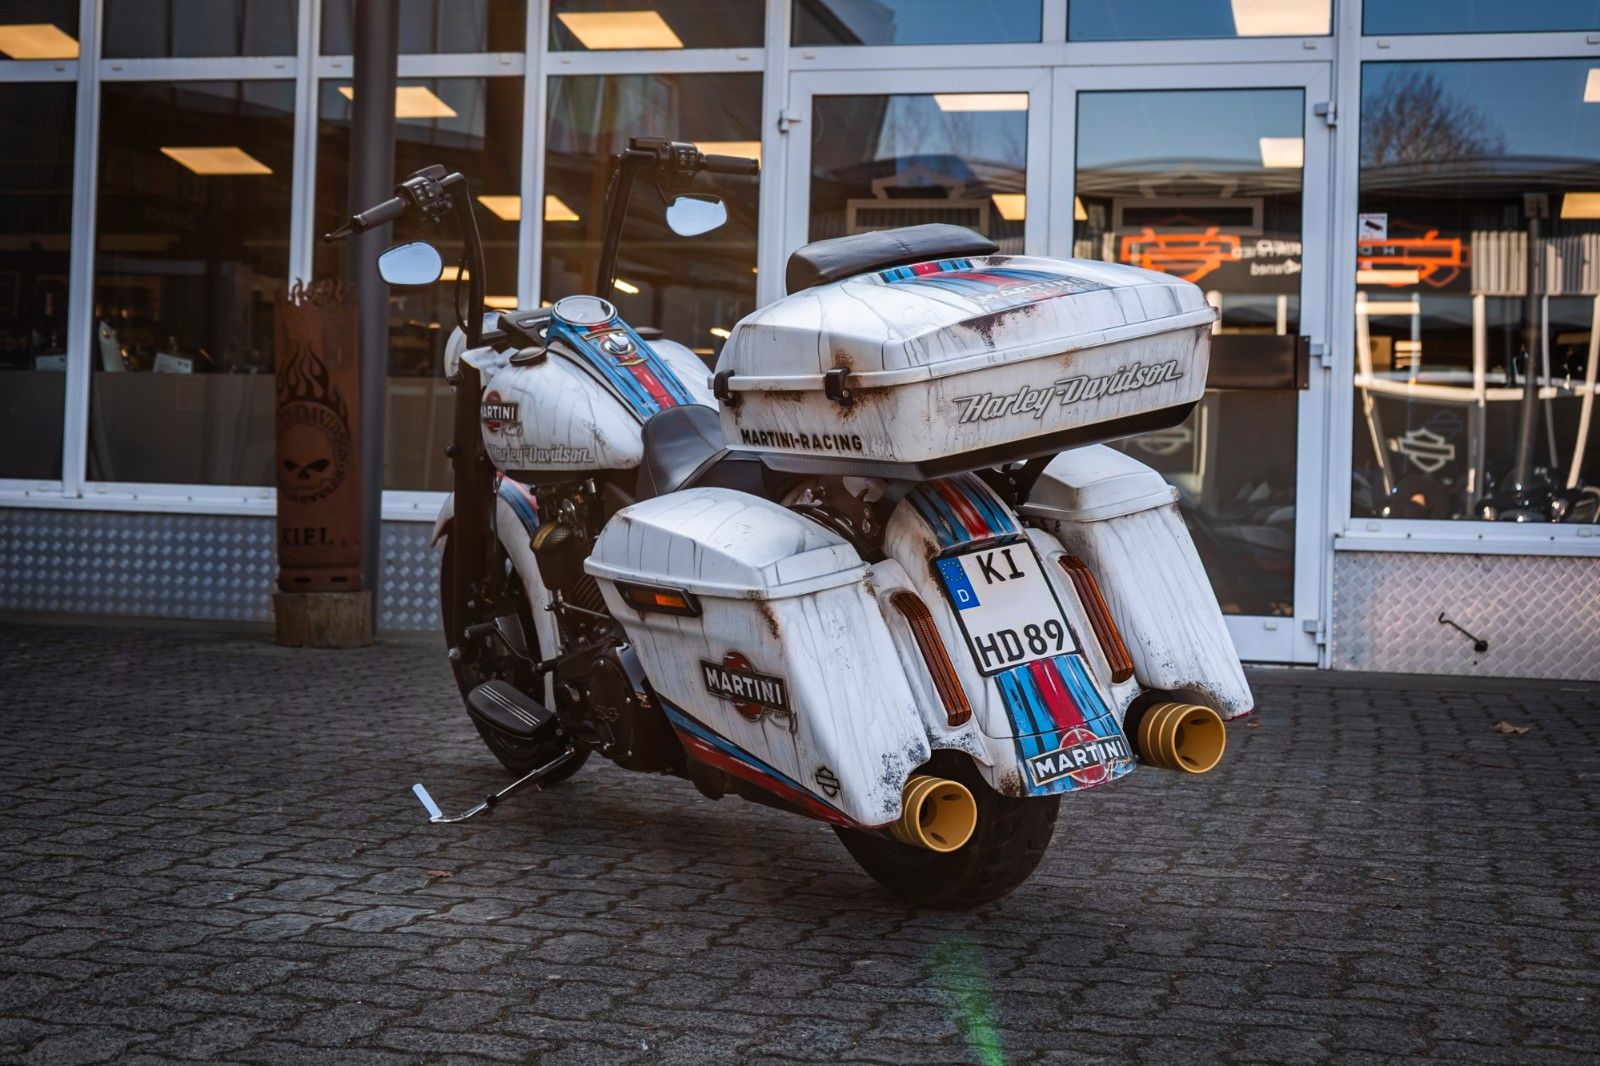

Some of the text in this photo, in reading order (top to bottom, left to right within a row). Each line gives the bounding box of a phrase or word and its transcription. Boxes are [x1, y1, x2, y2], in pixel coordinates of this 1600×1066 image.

[953, 359, 1183, 424] Harley-Davidson
[740, 428, 863, 452] MARTINI-RACING
[976, 549, 1025, 585] KI
[957, 589, 970, 602] D
[705, 667, 782, 705] MARTINI
[1035, 740, 1125, 778] MARTINI
